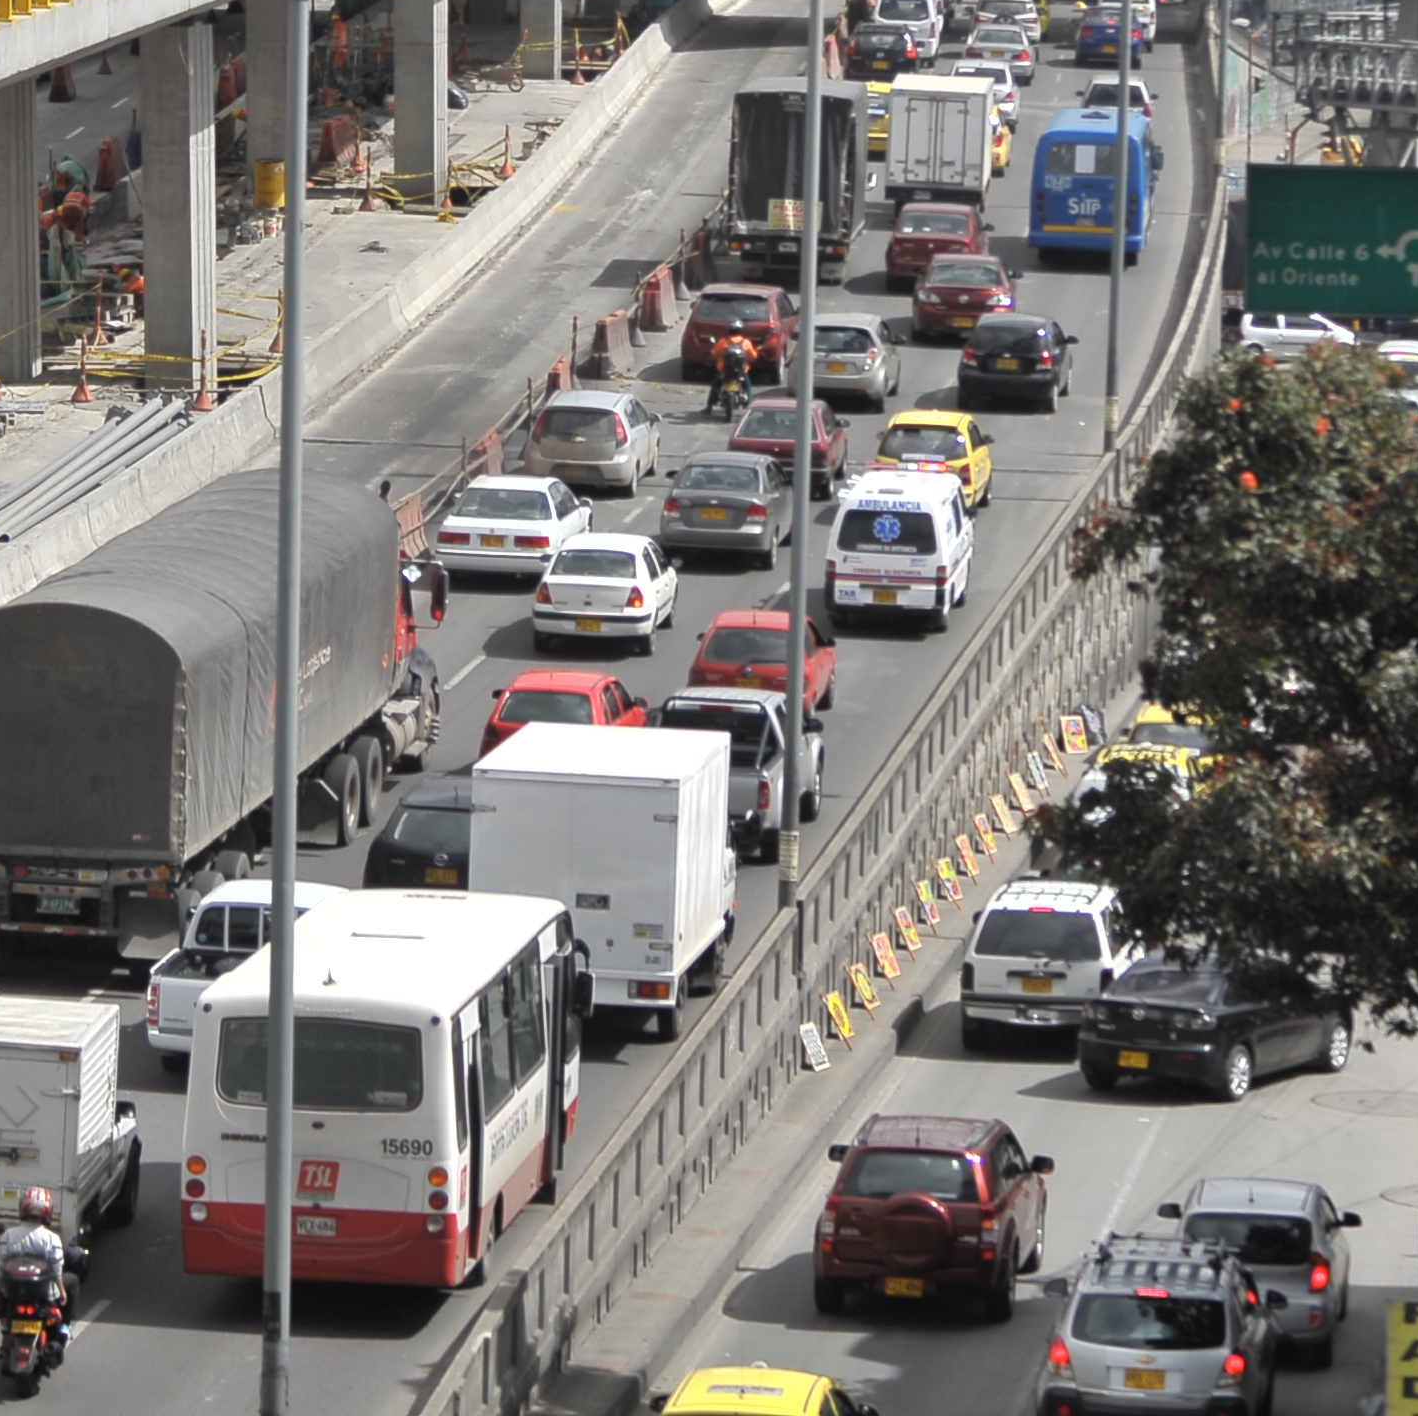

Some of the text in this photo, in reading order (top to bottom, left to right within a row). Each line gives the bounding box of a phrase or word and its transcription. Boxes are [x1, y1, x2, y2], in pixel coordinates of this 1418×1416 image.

[1253, 242, 1369, 261] Av Calle 6
[1257, 268, 1359, 286] al Oriente
[857, 499, 922, 512] AMBULANCIA
[381, 1138, 433, 1156] 15690
[303, 1164, 333, 1188] TSL
